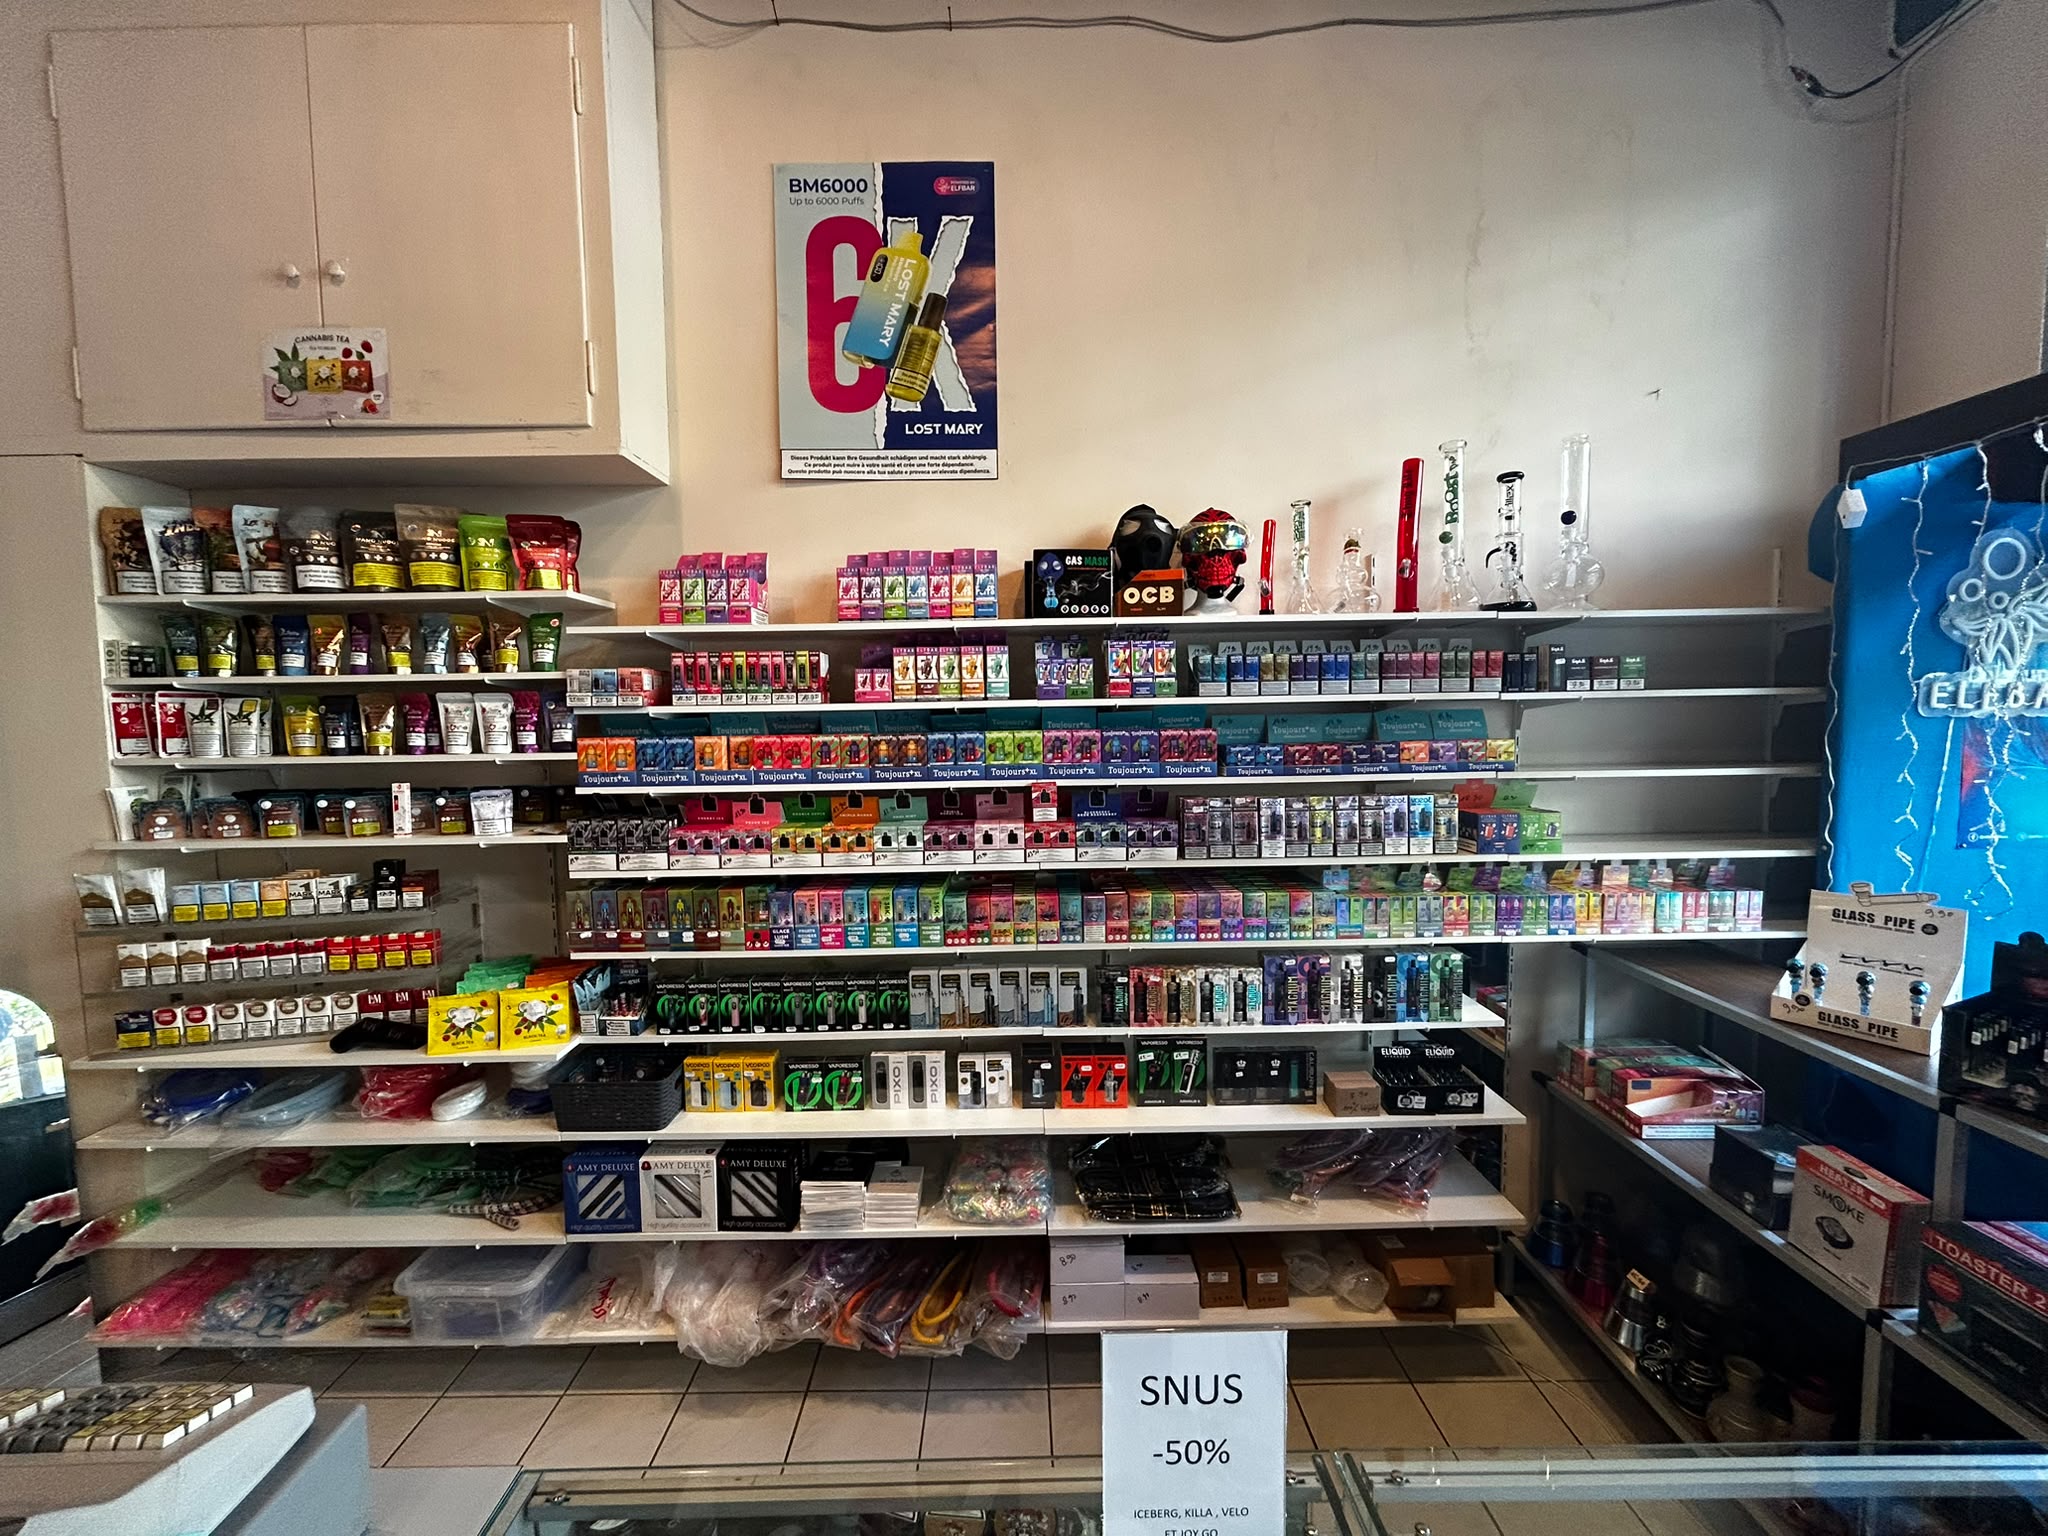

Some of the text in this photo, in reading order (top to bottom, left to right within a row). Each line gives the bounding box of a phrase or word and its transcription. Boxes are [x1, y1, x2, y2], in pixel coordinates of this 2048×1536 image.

[789, 178, 868, 194] BM6000
[789, 196, 865, 206] Up to 6000 Puffs
[878, 257, 917, 349] LOST MARY
[295, 334, 350, 344] CANNABIS TEA
[905, 424, 983, 435] LOST MARY
[1065, 555, 1109, 567] GAS MASK
[1123, 586, 1175, 604] OCB
[1832, 908, 1915, 930] GLASS PIPE
[1115, 986, 1123, 1012] MAGNUM
[1288, 975, 1298, 1013] MAGNUM
[1321, 974, 1331, 1012] MAGNUM
[1353, 974, 1364, 1011] MAGNUM
[1387, 974, 1397, 1010] MAGNUM
[1420, 973, 1430, 1009] MAGNUM
[1453, 972, 1463, 1009] MAGNUM
[1818, 1011, 1898, 1039] GLASS PIPE
[1381, 1047, 1411, 1056] ELIQUID
[1425, 1048, 1455, 1056] ELIQUID
[892, 1066, 901, 1104] PIXO
[930, 1066, 938, 1104] PIXO
[576, 1163, 635, 1172] AMY DELUXE
[653, 1160, 711, 1170] AMY DELUXE
[729, 1159, 787, 1168] AMY DELUXE
[1819, 1163, 1865, 1199] HEATER
[1813, 1184, 1865, 1224] SMOKE
[1937, 1237, 2028, 1301] TOASTER
[1140, 1374, 1243, 1406] SNUS
[1153, 1438, 1230, 1465] -50%
[1134, 1507, 1249, 1520] ICEBERG, KILLA VELO
